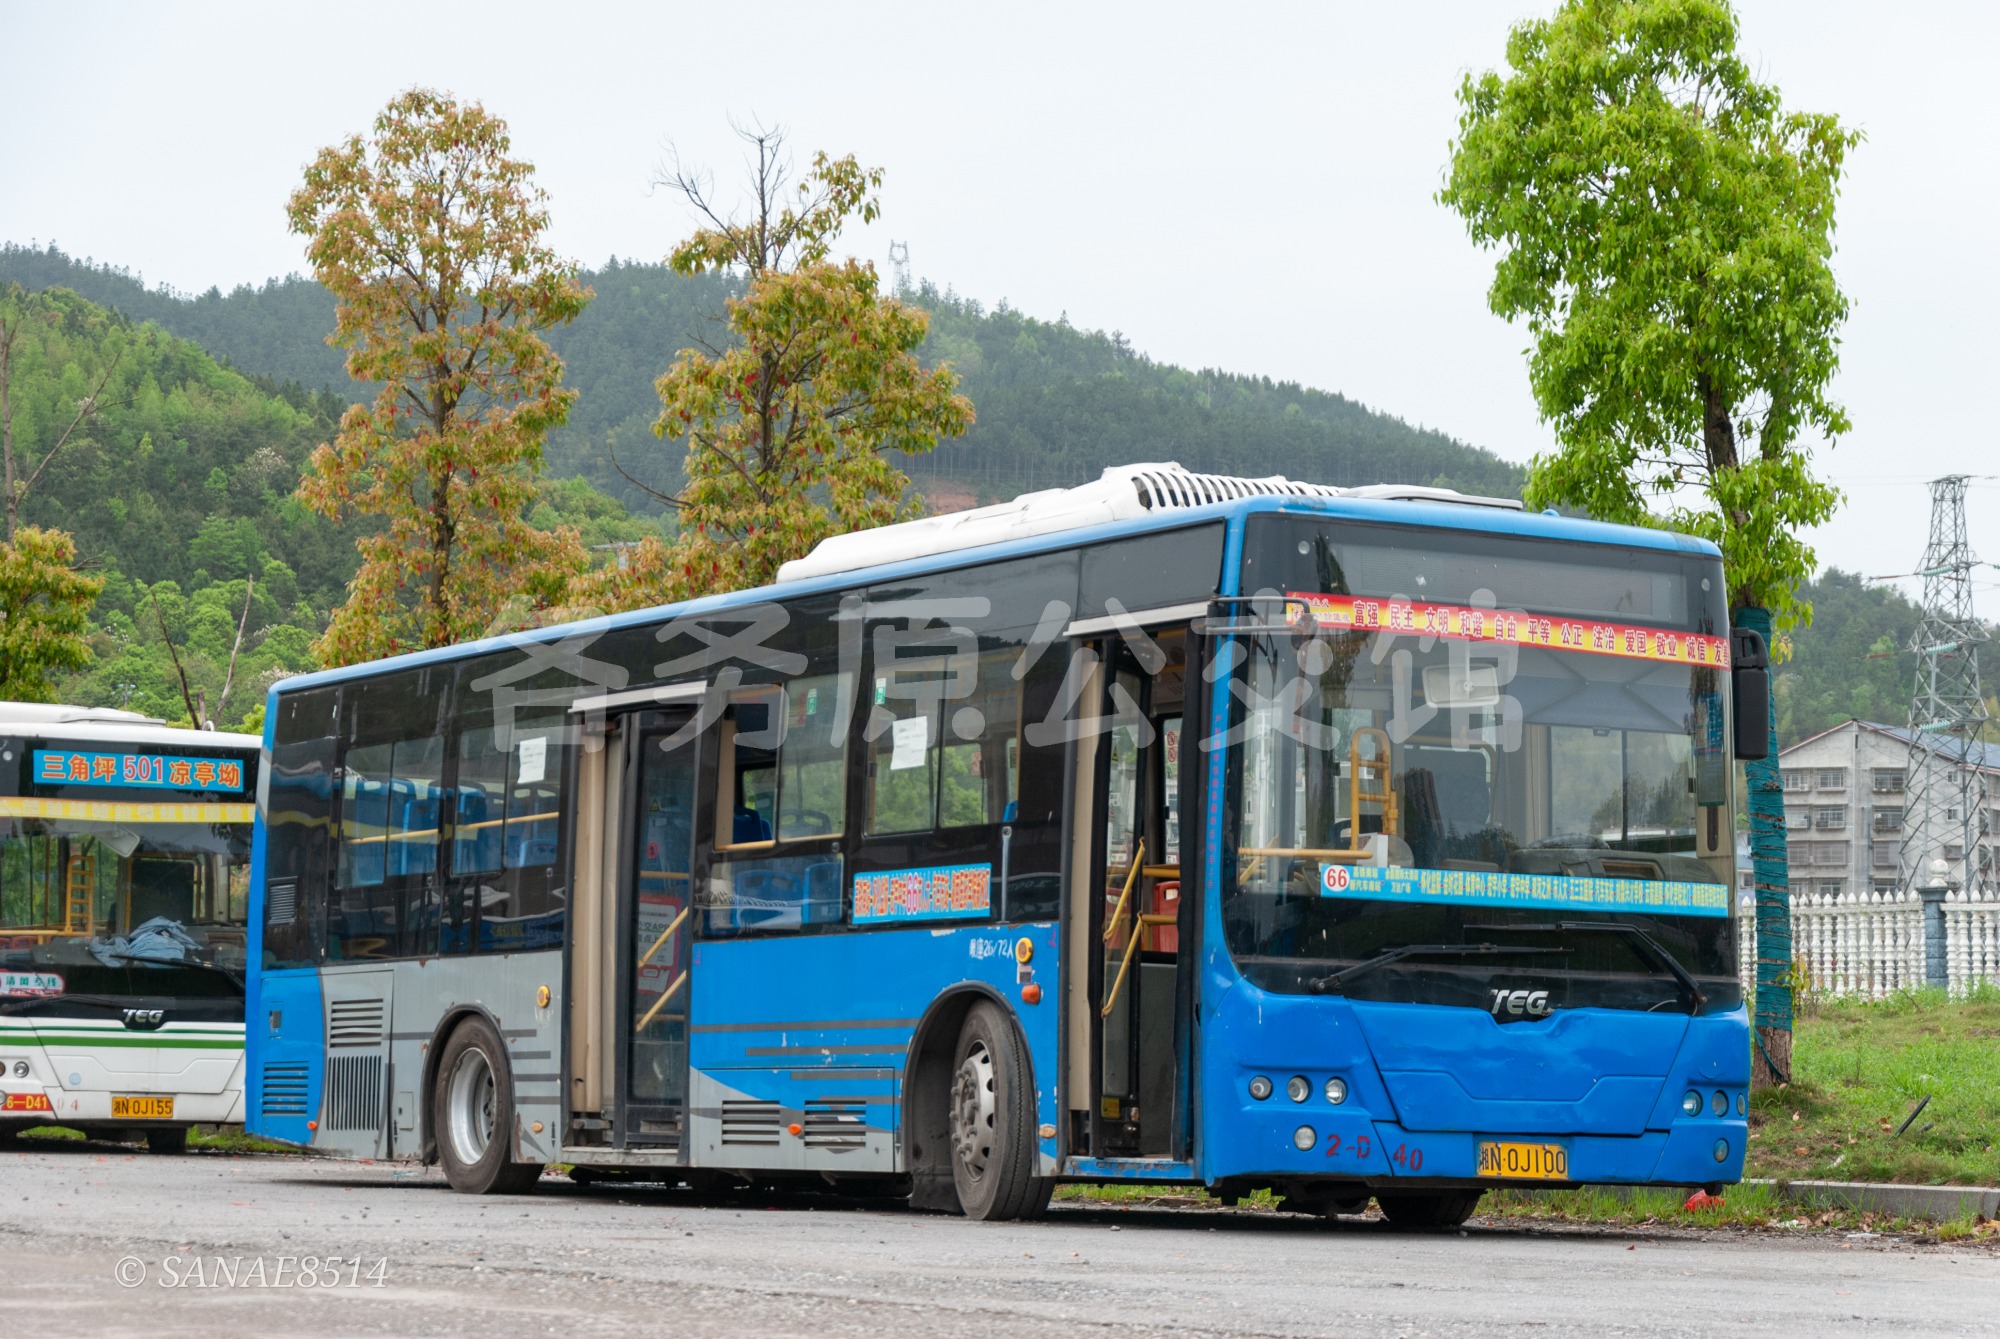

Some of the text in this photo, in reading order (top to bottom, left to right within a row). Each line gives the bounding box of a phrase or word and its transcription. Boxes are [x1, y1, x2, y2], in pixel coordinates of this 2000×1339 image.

[1353, 600, 1379, 627] 富强
[1389, 603, 1415, 630] 民主
[1425, 607, 1449, 634] 文明
[1459, 610, 1484, 638] 和谐
[1494, 613, 1517, 641] 自由
[1527, 617, 1551, 644] 平等
[1560, 621, 1584, 647] 公正
[1592, 624, 1616, 651] 法治
[1624, 628, 1647, 654] 爱国
[1656, 632, 1677, 658] 敬业
[1685, 636, 1706, 662] 诚信
[42, 754, 241, 788] 三角坪 501 凉亭坳
[1326, 868, 1347, 888] 66
[906, 872, 919, 915] 66
[1490, 988, 1549, 1014] TEG
[123, 1008, 163, 1023] TEG
[1393, 1143, 1423, 1171] 40
